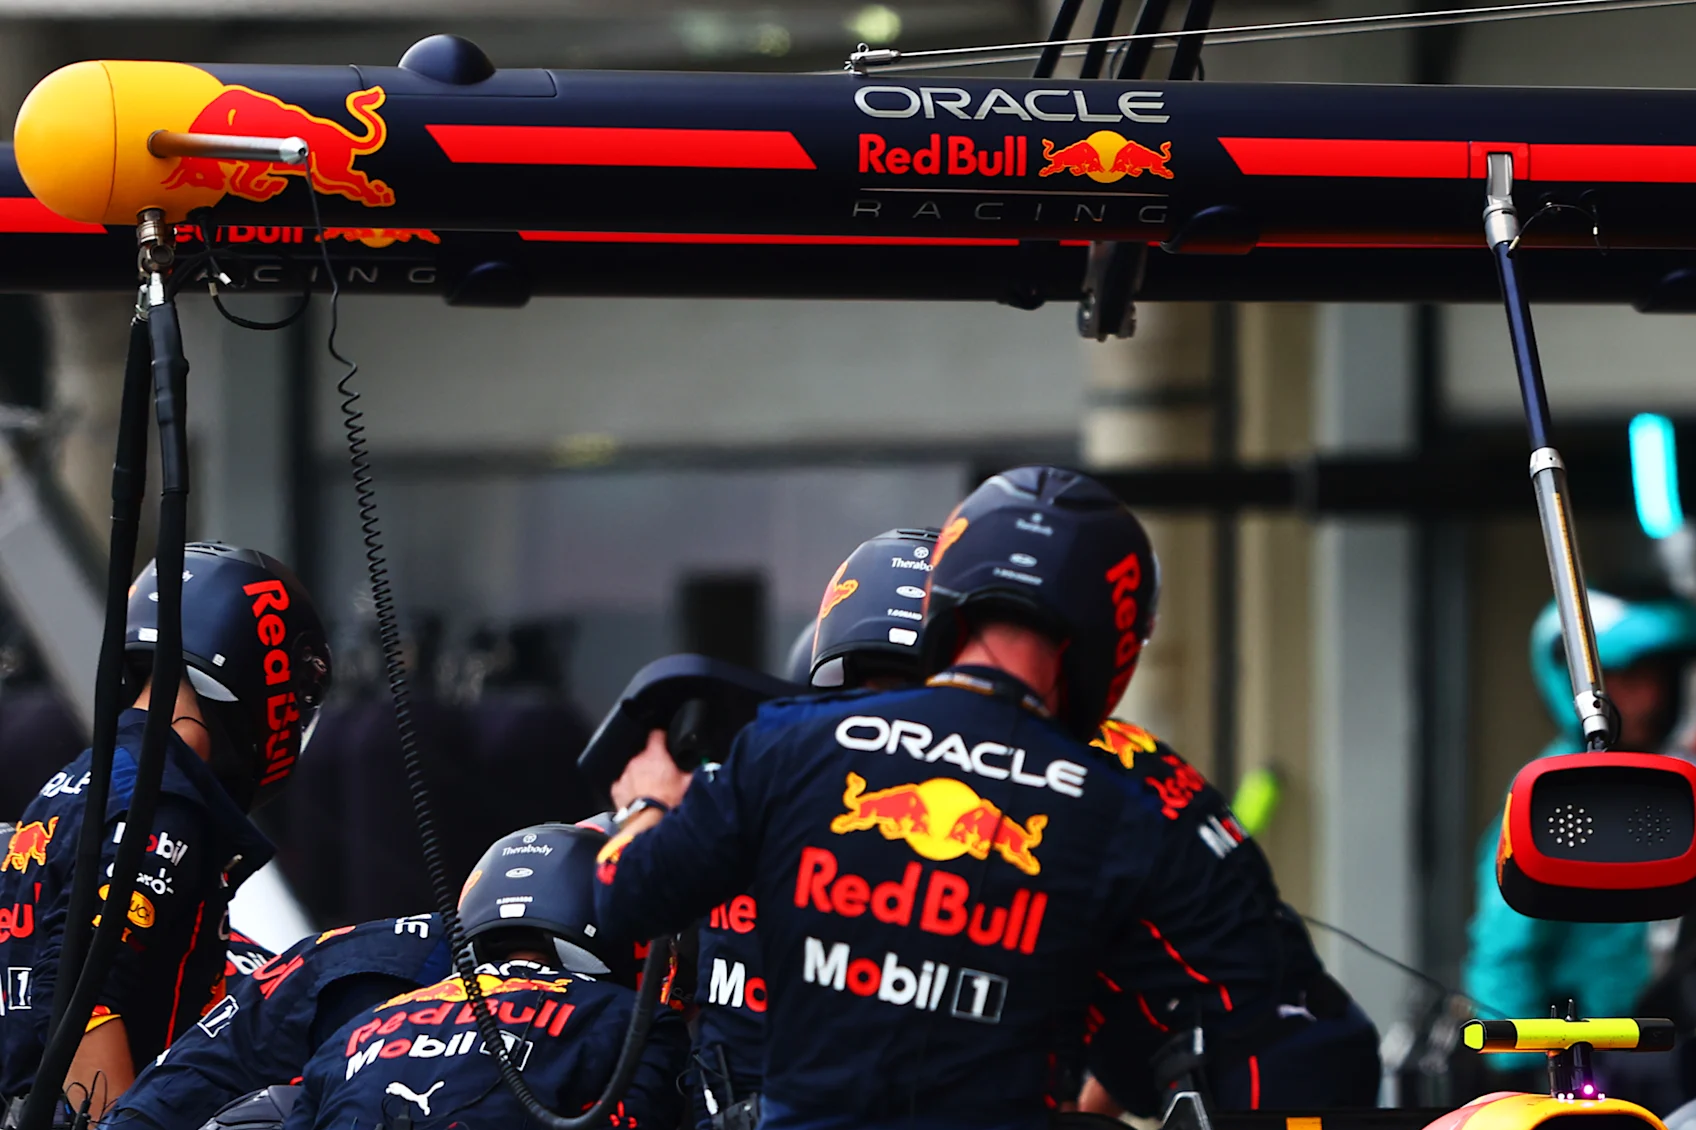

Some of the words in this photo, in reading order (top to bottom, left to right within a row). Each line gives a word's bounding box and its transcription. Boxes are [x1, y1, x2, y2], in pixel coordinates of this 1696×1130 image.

[854, 86, 1170, 123] ORACLE
[858, 133, 940, 175] Red
[948, 135, 1027, 177] Bull
[852, 201, 1168, 224] RACING
[891, 557, 933, 572] Therabo
[835, 715, 1088, 798] ORACLE
[502, 844, 553, 857] Therabody
[794, 845, 923, 926] Red
[919, 869, 1048, 955] Bull
[803, 936, 949, 1011] Mobil
[346, 1031, 477, 1081] Mobil
